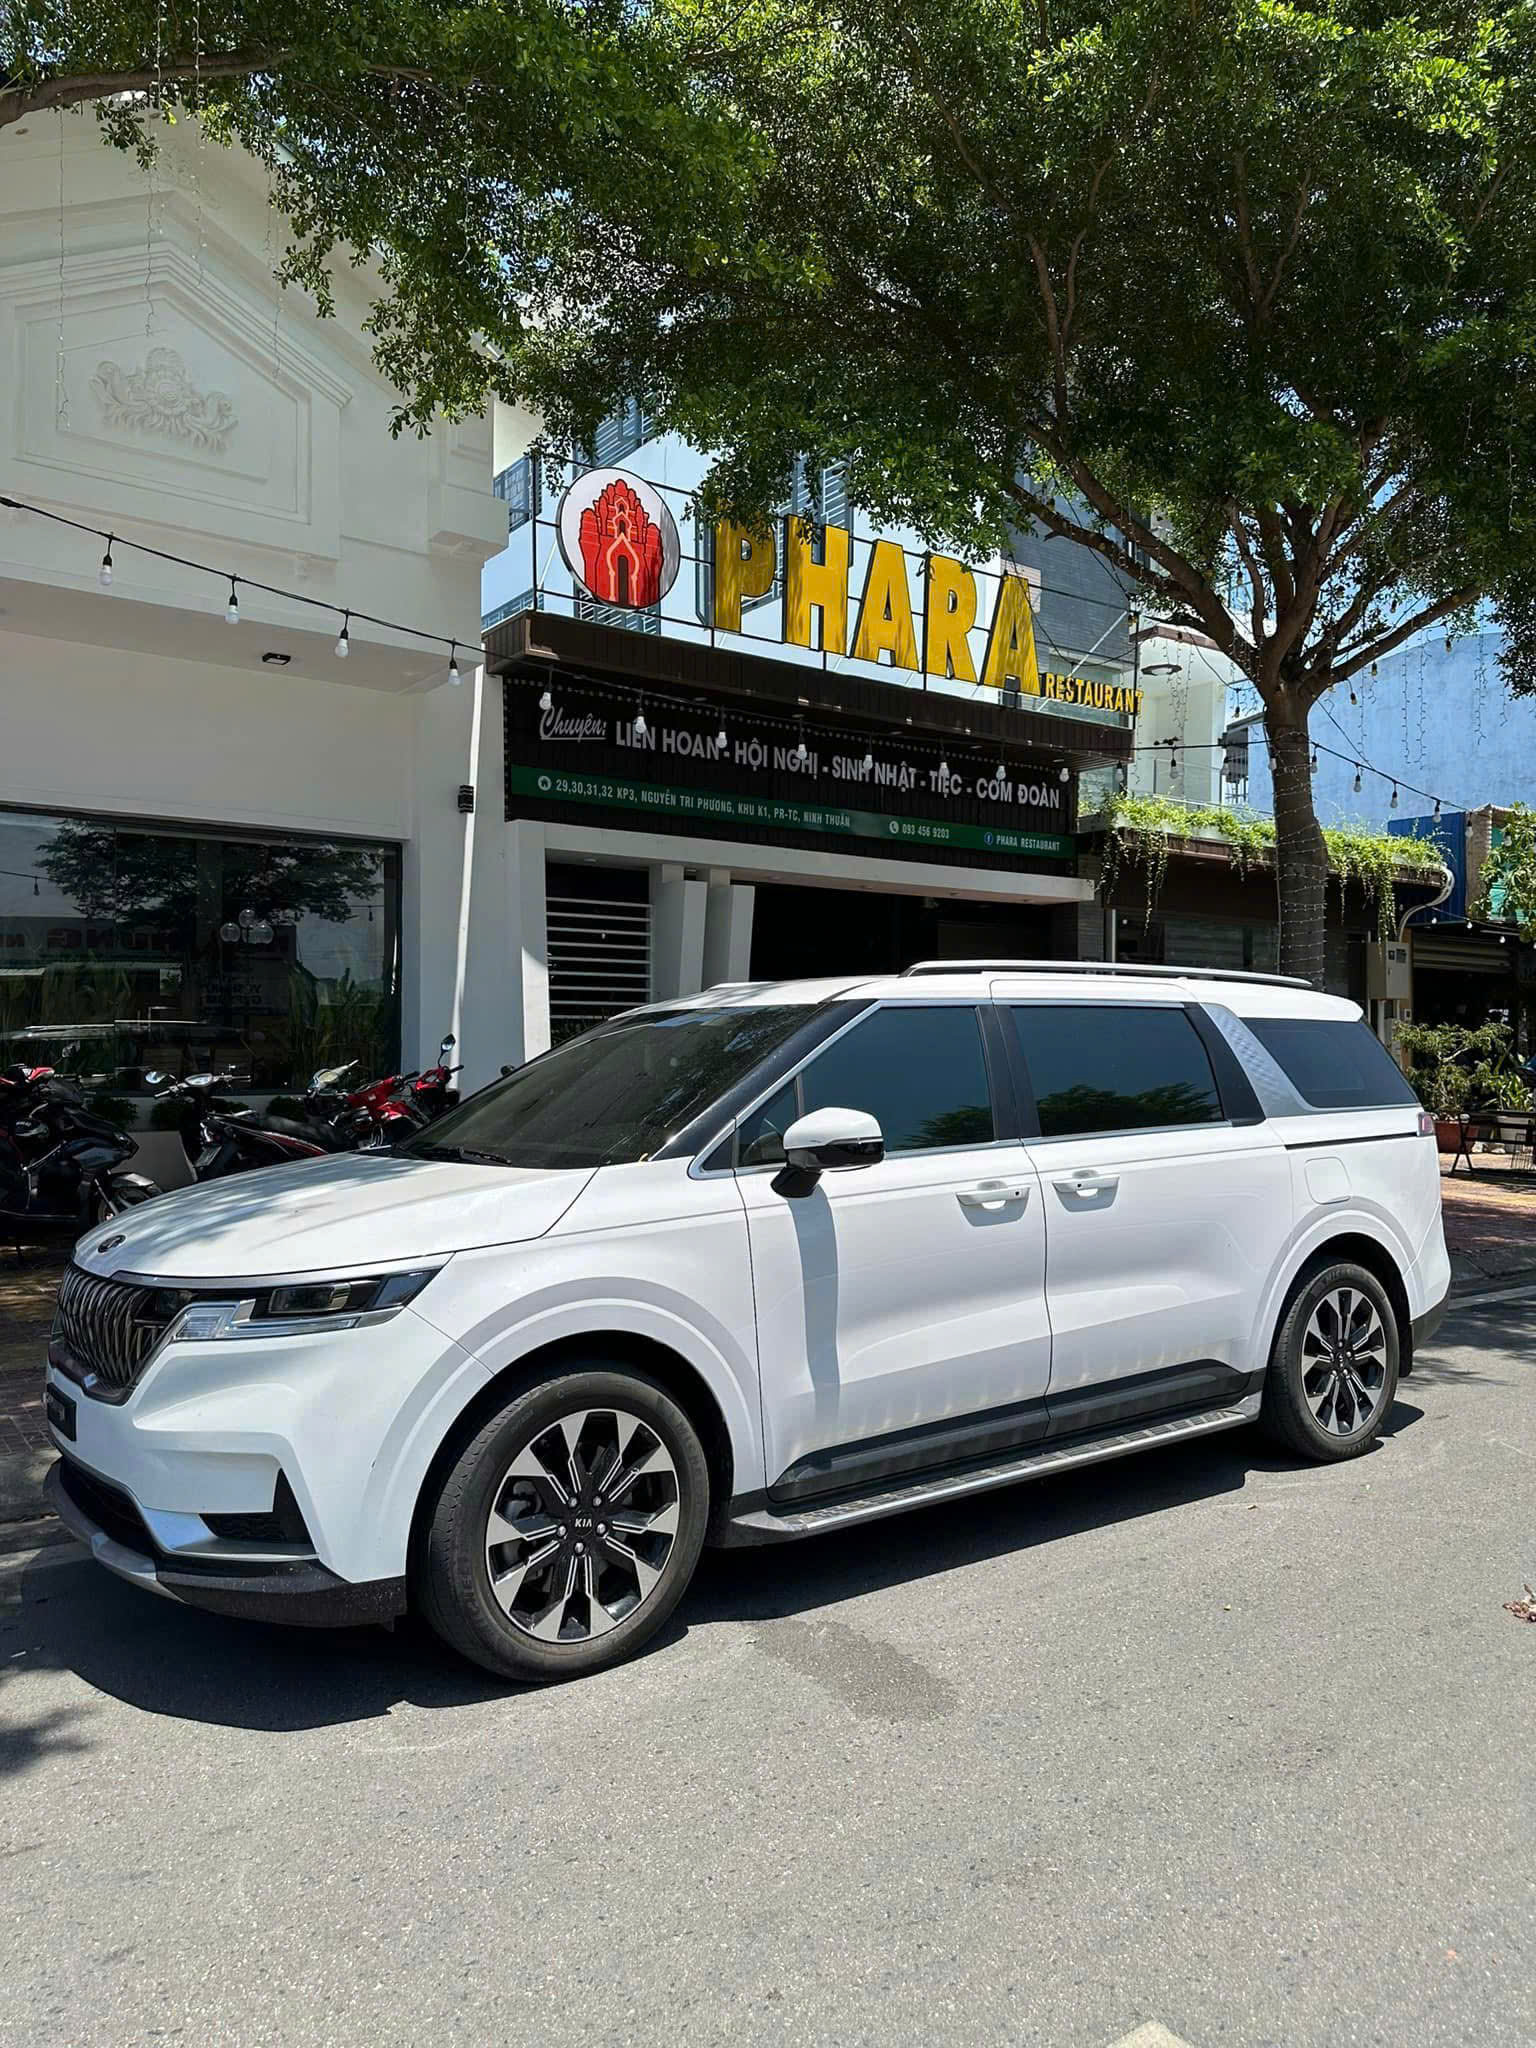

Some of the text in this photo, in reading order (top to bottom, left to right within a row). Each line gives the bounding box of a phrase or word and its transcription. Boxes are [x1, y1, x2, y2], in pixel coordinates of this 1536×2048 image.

[712, 499, 1040, 697] PHARA
[1044, 672, 1144, 714] RESTAURANT
[662, 728, 720, 762] HOAN
[735, 738, 769, 773] HỘI
[774, 747, 820, 781] NGHỊ
[831, 755, 871, 784] SINH
[874, 760, 916, 792] NHẬT
[1018, 781, 1060, 809] ĐOÀN
[738, 802, 755, 816] KHU
[996, 835, 1060, 852] PHARA RESTAURANT
[574, 1518, 592, 1528] KIA
